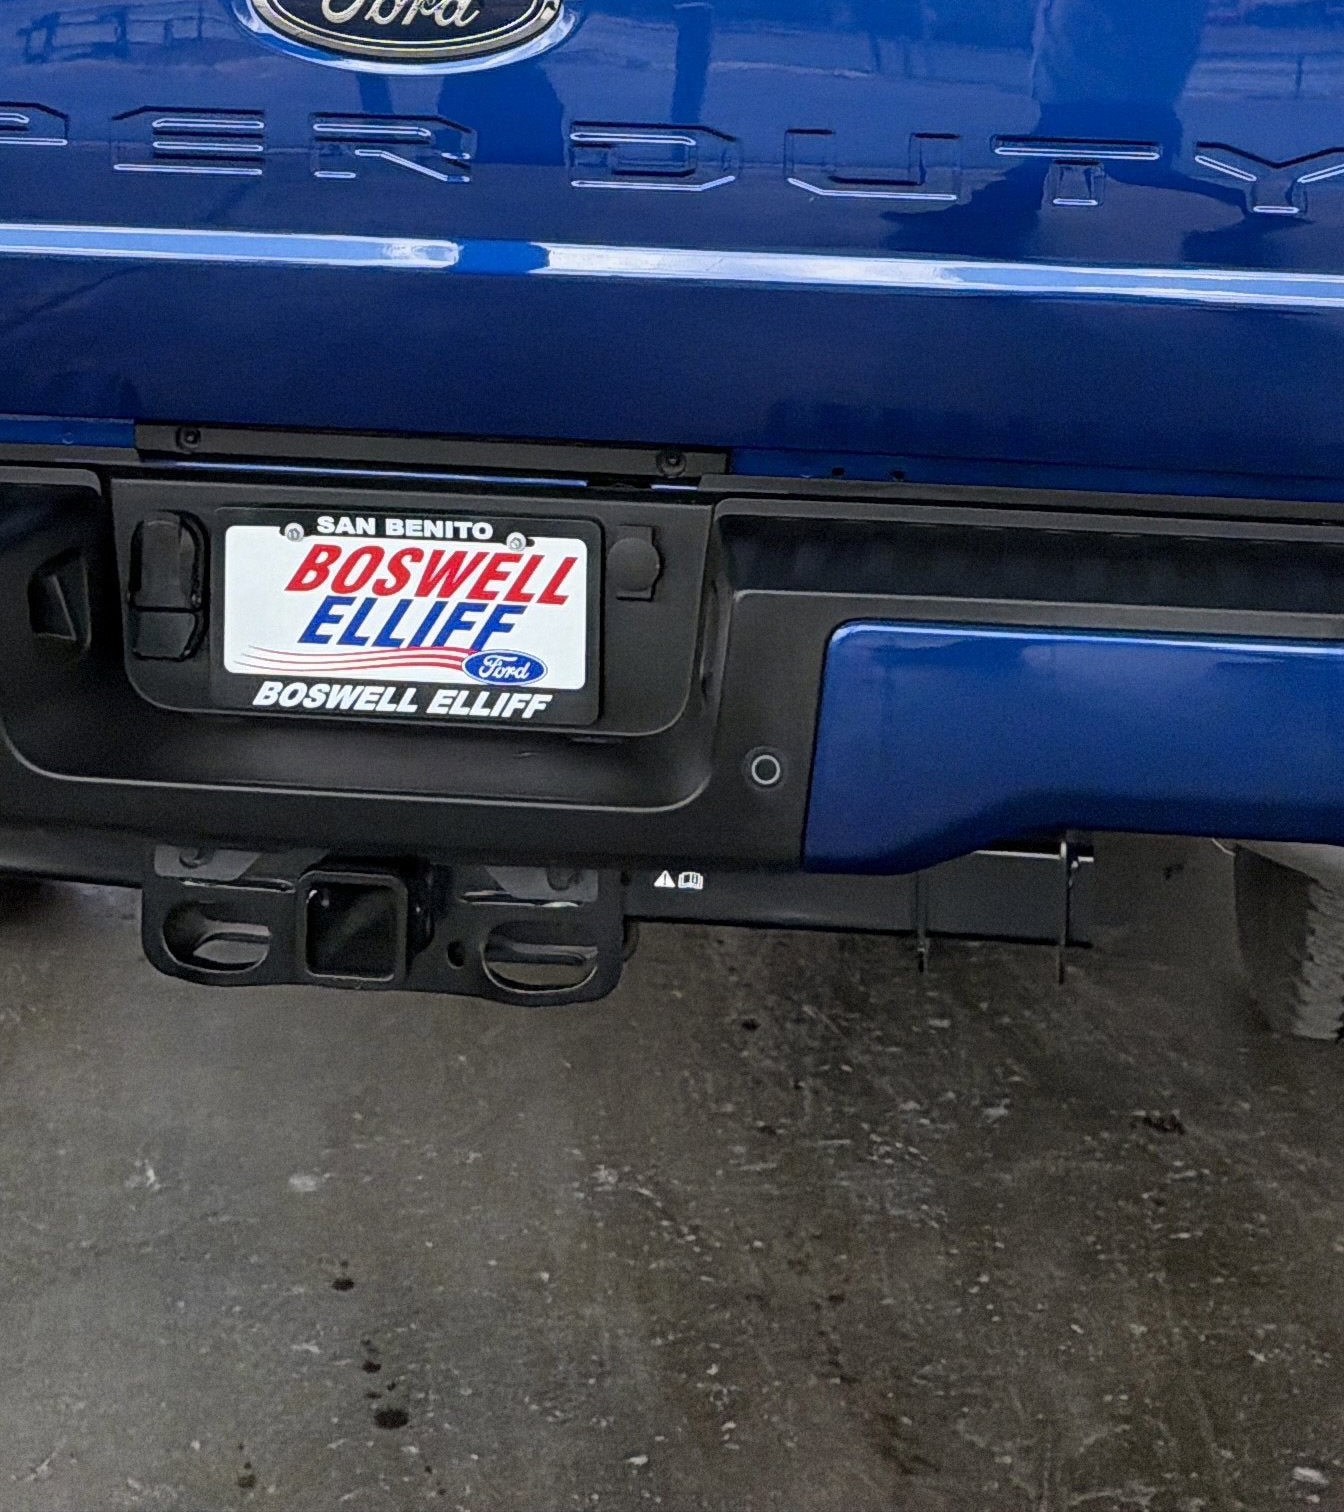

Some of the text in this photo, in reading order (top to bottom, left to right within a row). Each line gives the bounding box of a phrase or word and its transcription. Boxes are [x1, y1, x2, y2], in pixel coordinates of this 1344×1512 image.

[316, 515, 494, 541] SAN BENITO
[284, 543, 579, 606] BOSWELL
[297, 594, 528, 652] ELLIFF
[478, 654, 531, 681] Ford
[252, 680, 554, 719] BOSWELL ELLIFF
